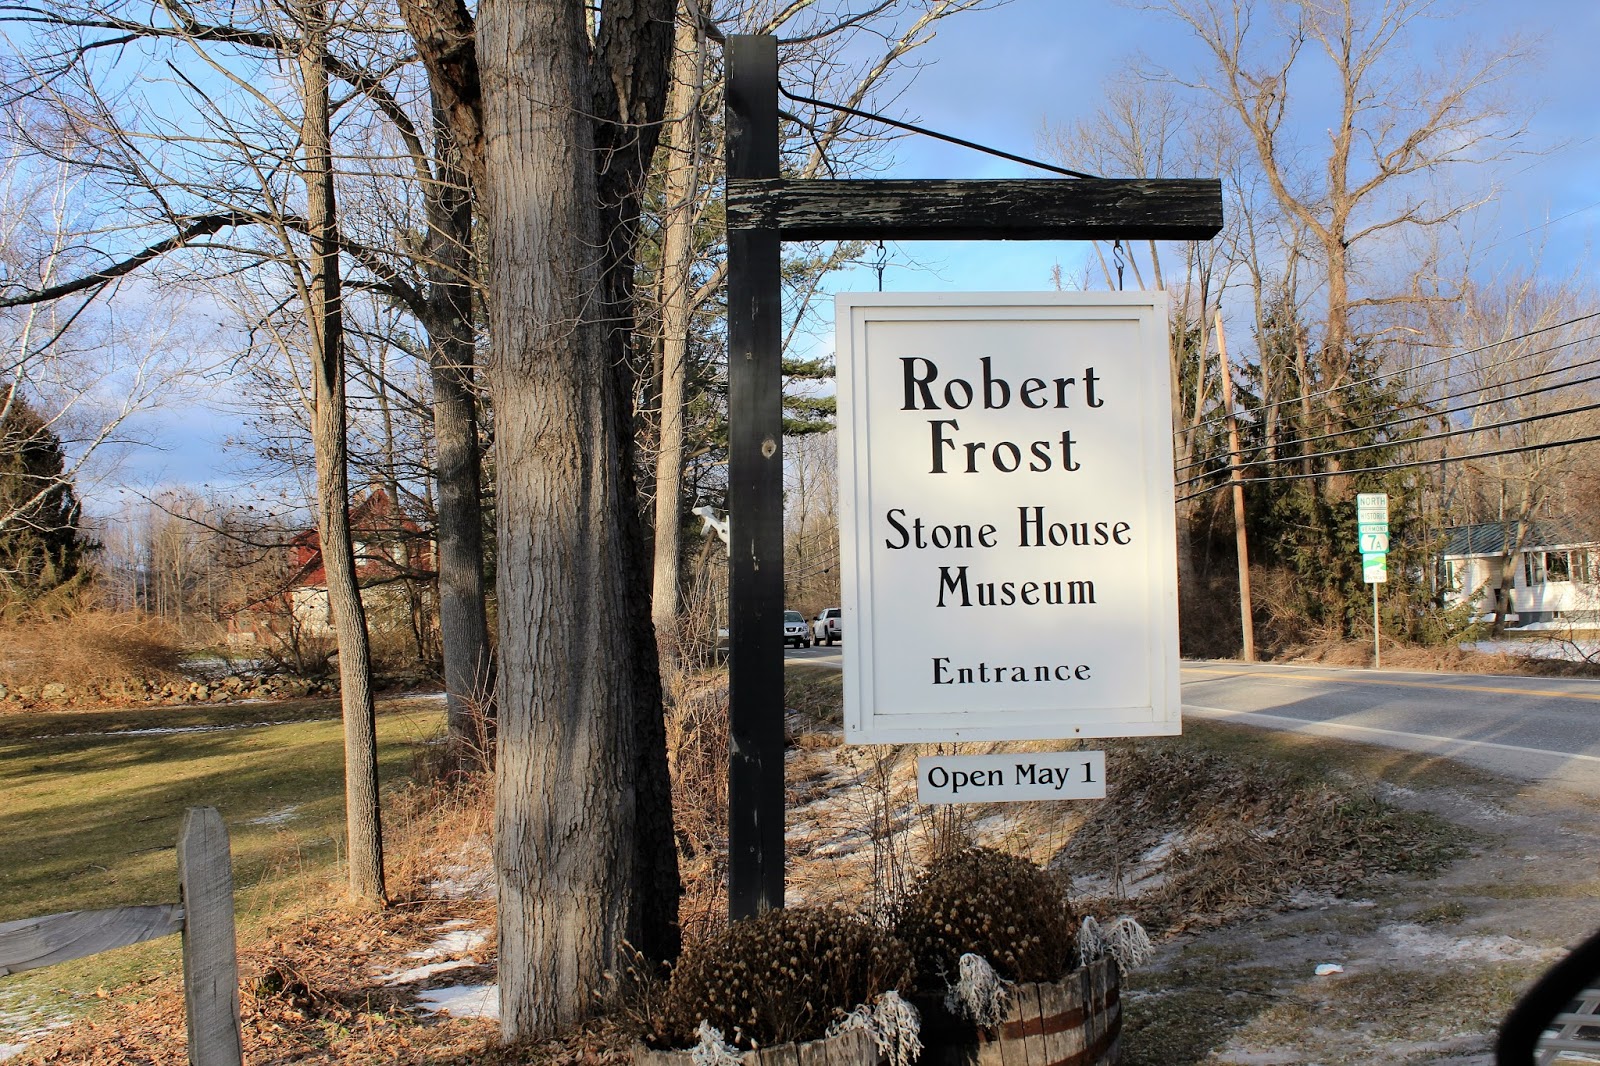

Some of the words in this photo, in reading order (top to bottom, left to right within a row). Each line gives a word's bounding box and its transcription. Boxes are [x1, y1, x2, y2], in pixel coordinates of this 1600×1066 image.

[899, 357, 1104, 411] Robert
[927, 419, 1081, 473] Frost
[1360, 497, 1386, 506] NORTH
[1361, 512, 1386, 520] HISTORIC
[885, 508, 998, 550] Stone
[1017, 506, 1132, 548] House
[936, 566, 1097, 608] Museum
[932, 657, 1091, 685] Entrance
[928, 766, 1004, 793] Open
[1015, 763, 1070, 790] May
[1081, 762, 1097, 783] 1
